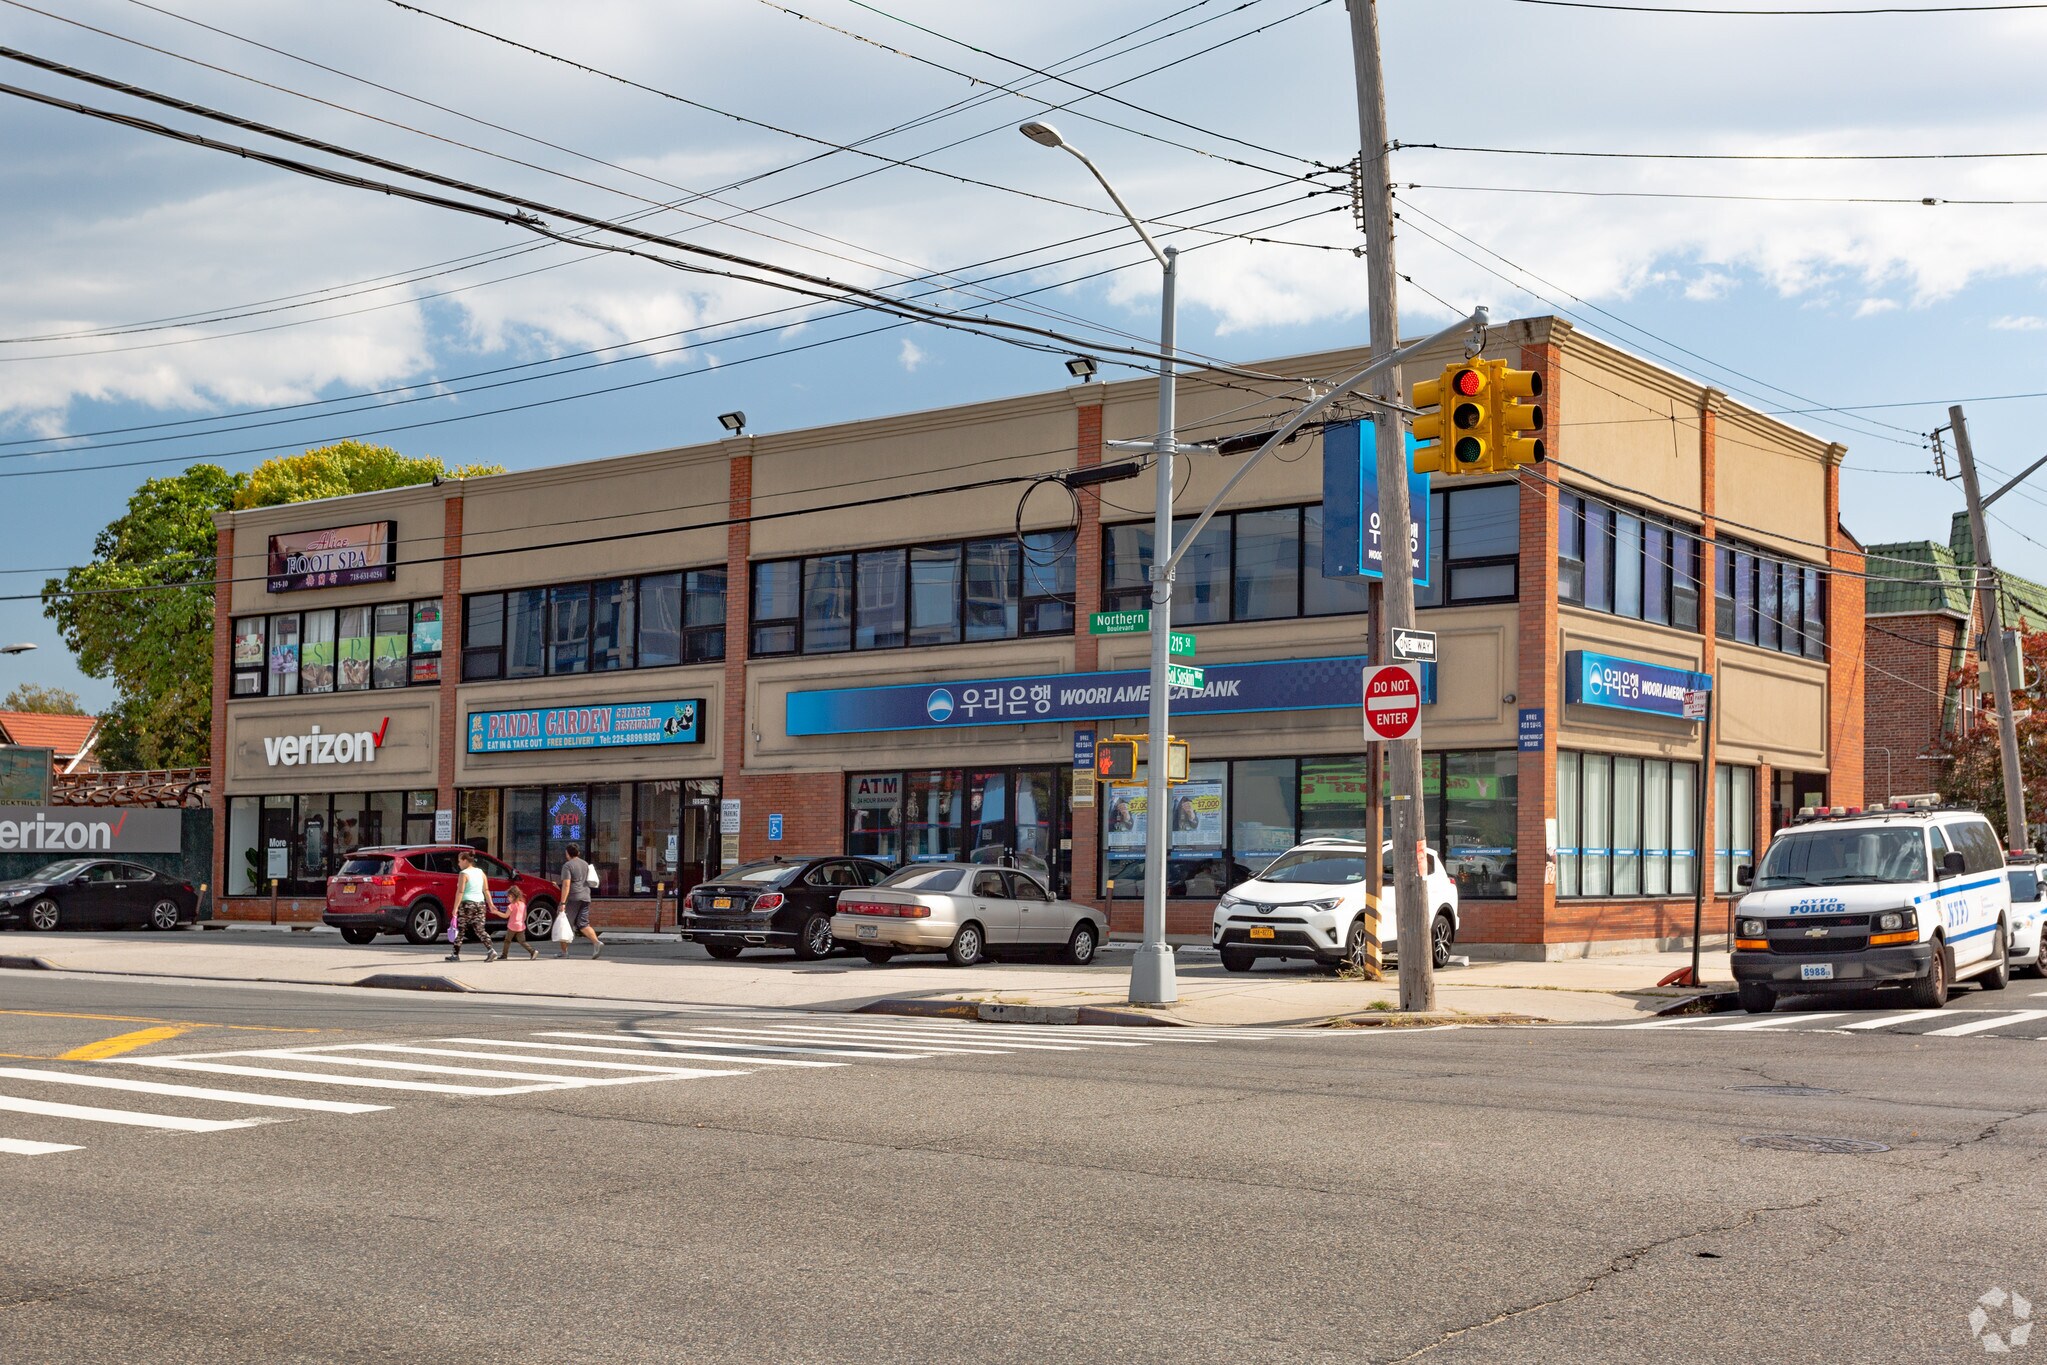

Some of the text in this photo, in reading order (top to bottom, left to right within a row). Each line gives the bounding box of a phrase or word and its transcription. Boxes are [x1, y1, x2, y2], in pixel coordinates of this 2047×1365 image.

[286, 550, 367, 575] FOOT SPA
[1097, 613, 1144, 626] Northern
[1106, 624, 1134, 632] Boulevard
[1171, 636, 1191, 652] 215 St
[1399, 638, 1431, 652] ONE WAY
[1374, 680, 1410, 693] DO NOT
[1603, 668, 1639, 699] 우리은행
[1641, 680, 1663, 697] WOORI
[960, 685, 1051, 717] 우리은행
[1060, 686, 1111, 706] WOORI
[1113, 685, 1189, 703] AMECA
[616, 706, 651, 719] CHINESE
[1376, 712, 1409, 725] ENTER
[488, 707, 612, 739] PANDA GARDEN
[614, 718, 662, 731] RESTAURANT
[263, 725, 375, 766] verizon
[487, 740, 498, 750] EAT
[513, 739, 529, 749] TAKE
[530, 739, 542, 748] OUT
[547, 737, 563, 747] FREE
[564, 736, 595, 746] DELIVERY
[600, 735, 611, 744] Tel:
[858, 778, 897, 794] ATM
[550, 794, 566, 816] Panda
[1197, 800, 1220, 809] $7,000
[555, 813, 579, 825] OPEN
[269, 838, 287, 847] More
[669, 837, 676, 846] A
[1789, 903, 1846, 915] POLICE
[1804, 967, 1826, 977] 8988
